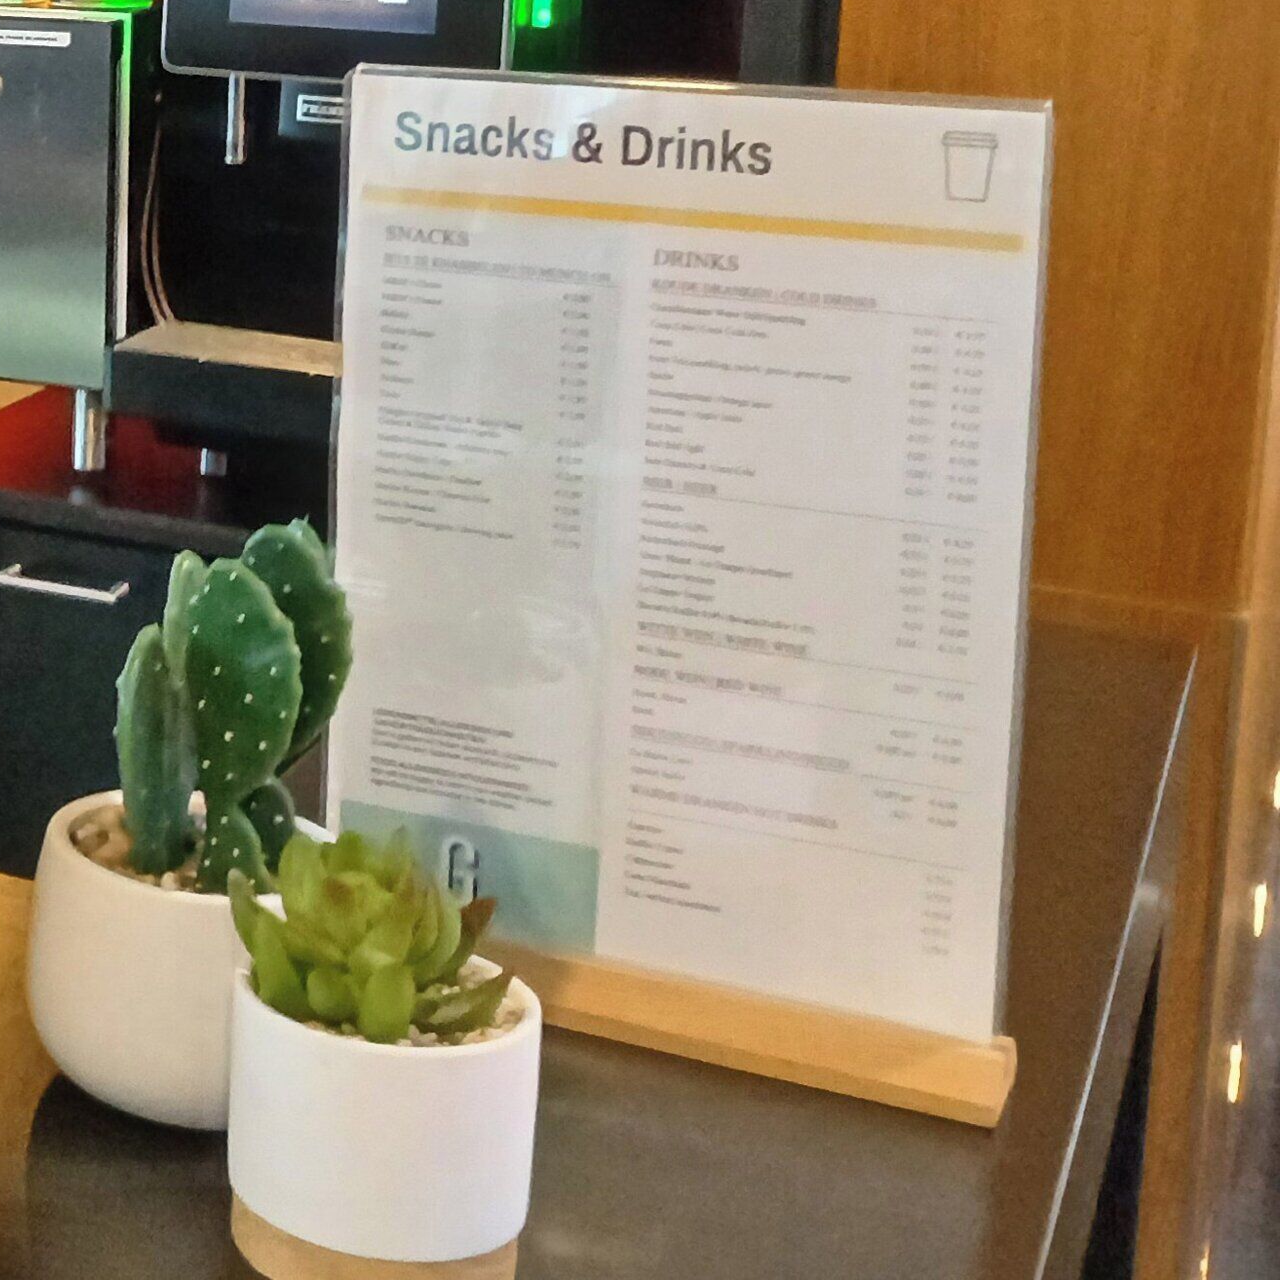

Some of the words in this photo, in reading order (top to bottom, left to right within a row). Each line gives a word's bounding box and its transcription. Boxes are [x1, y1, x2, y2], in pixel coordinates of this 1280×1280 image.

[393, 110, 554, 162] Snacks
[571, 122, 603, 163] &
[621, 124, 774, 177] Drinks
[652, 248, 740, 272] DRINKS
